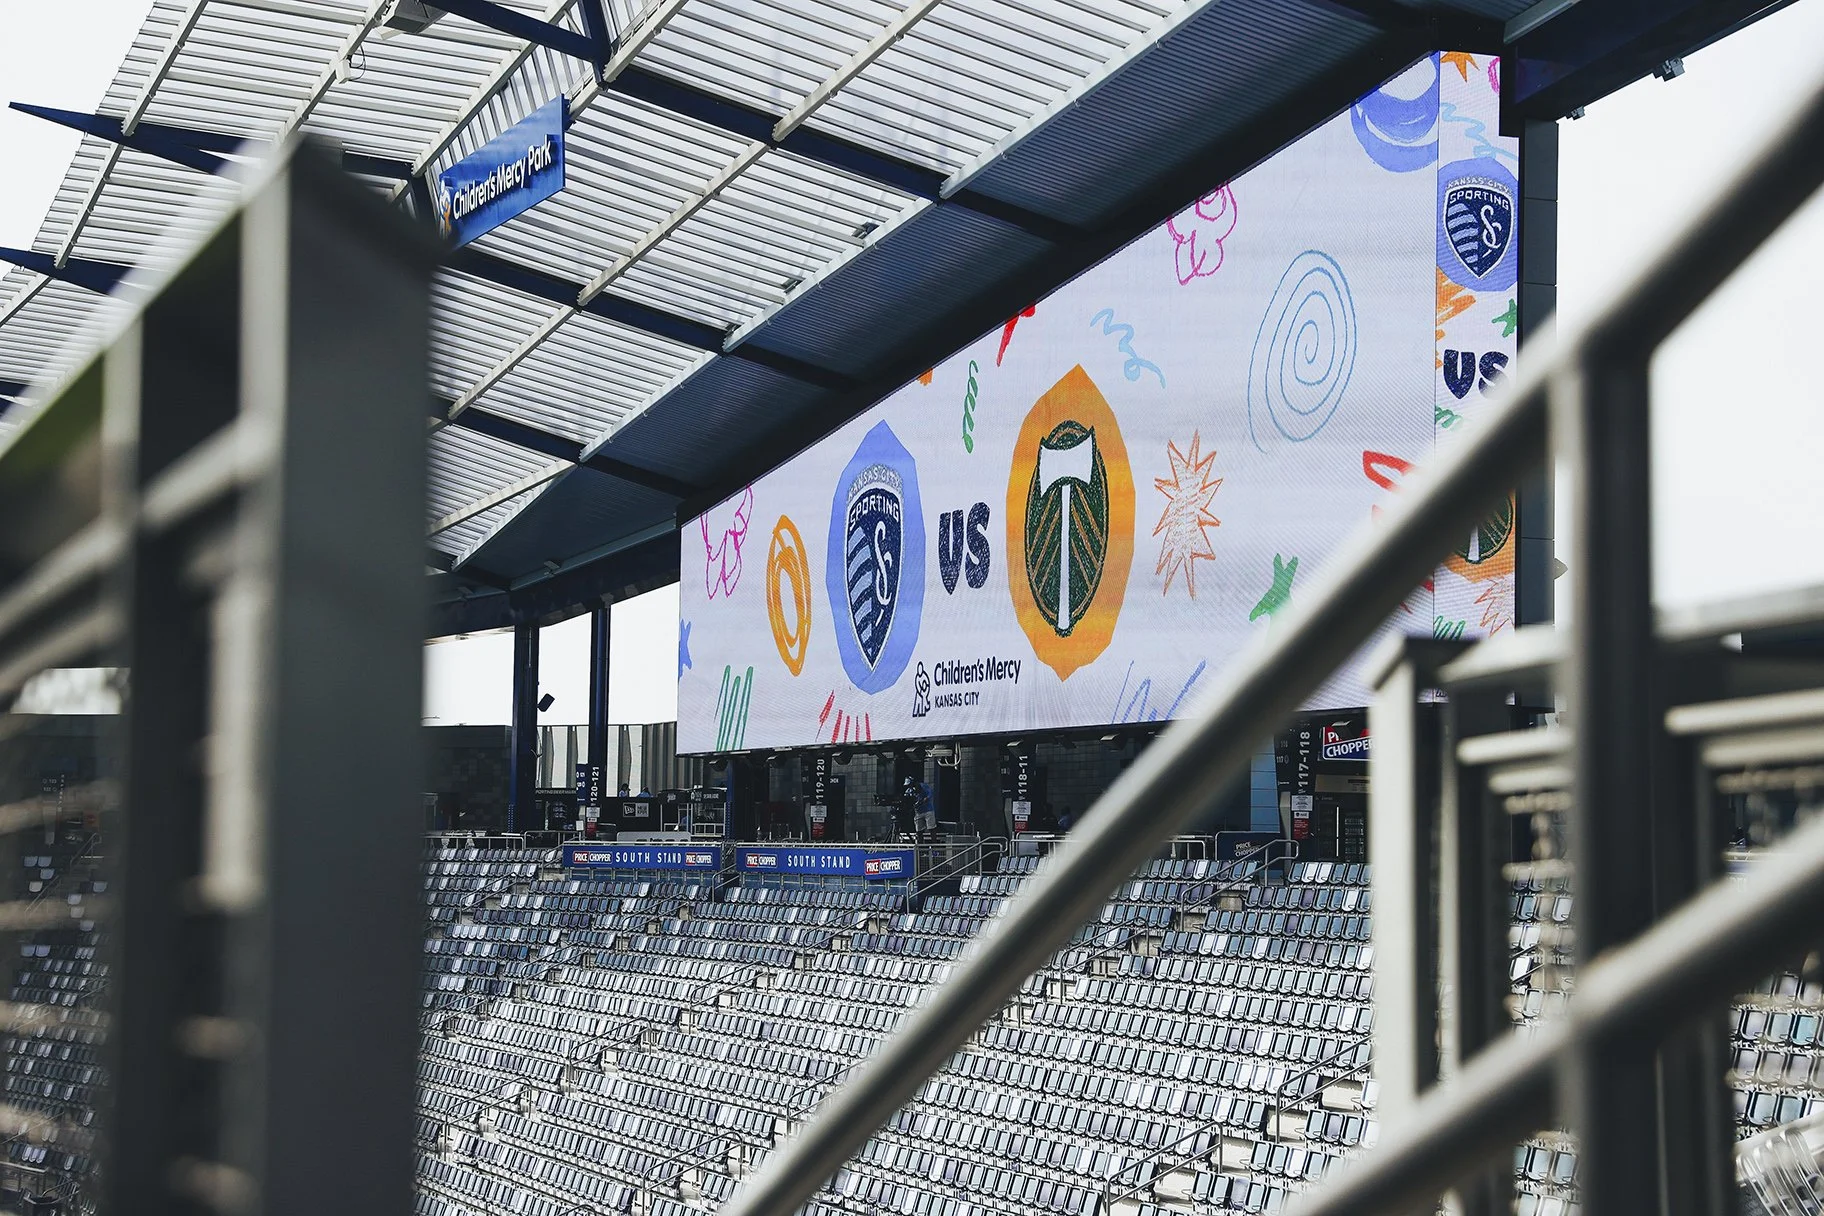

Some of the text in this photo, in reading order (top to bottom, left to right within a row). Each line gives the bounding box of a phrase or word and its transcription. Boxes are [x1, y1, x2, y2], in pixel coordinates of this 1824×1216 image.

[452, 134, 552, 220] Children's Mercy Park
[1447, 177, 1511, 194] KANSAS CITY
[1449, 190, 1509, 211] SPORTING
[848, 466, 879, 503] KANSAS
[849, 494, 900, 532] SPORTING
[933, 656, 1021, 687] Children's Mercy
[934, 691, 980, 708] KANSAS CITY
[1298, 731, 1311, 785] 117-118
[590, 766, 600, 802] 120-121
[1018, 755, 1028, 794] 118-11
[574, 852, 588, 862] PRICE
[589, 852, 611, 862] CHOPPER
[615, 852, 650, 863] SOUTH
[657, 852, 682, 864] STAND
[746, 855, 851, 869] PRICE CHOPPER SOUTH STAND
[866, 860, 901, 873] PRICE CHOPPER
